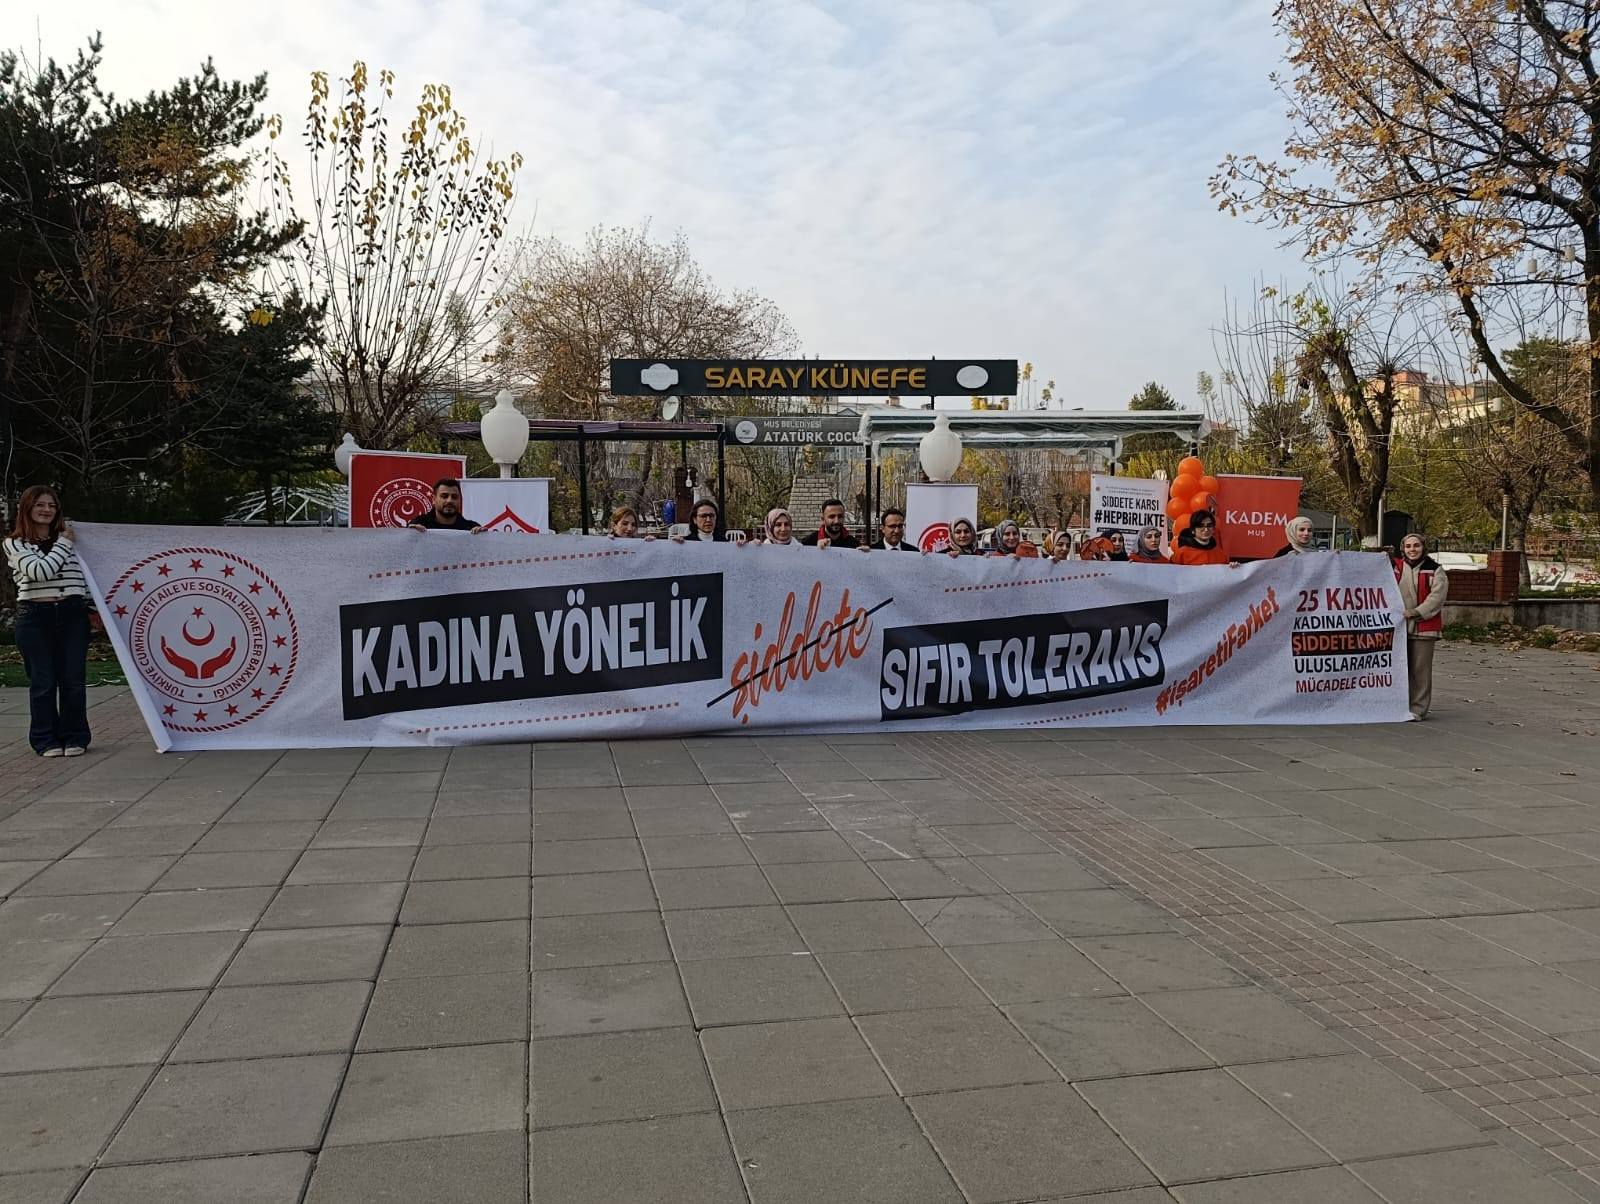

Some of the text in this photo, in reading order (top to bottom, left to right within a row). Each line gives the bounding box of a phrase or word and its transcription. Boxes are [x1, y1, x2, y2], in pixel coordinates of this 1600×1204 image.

[705, 363, 926, 388] SARAY KÜNEFE
[763, 429, 861, 444] ATATÜRK ÇOCU
[1225, 511, 1288, 526] KADEM
[1296, 588, 1388, 612] 25 KASIM
[1294, 612, 1393, 630] KADINA YÖNELİK
[134, 582, 264, 698] TÜRKİYE CUMHURİYETİ AİLE VE SOSYAL HİZMETLER BAKANLIĞI
[352, 613, 524, 697] KADINA
[535, 581, 708, 676] YÖNELİK
[881, 643, 972, 711] SIFIR
[978, 623, 1164, 700] TOLERANS
[1156, 585, 1280, 716] #işaretiFarket
[1293, 632, 1392, 655] ŞİDDETE KARŞI
[1295, 653, 1392, 673] ULUSLARARASI
[1296, 672, 1392, 693] MÜCADELE GÜNÜ
